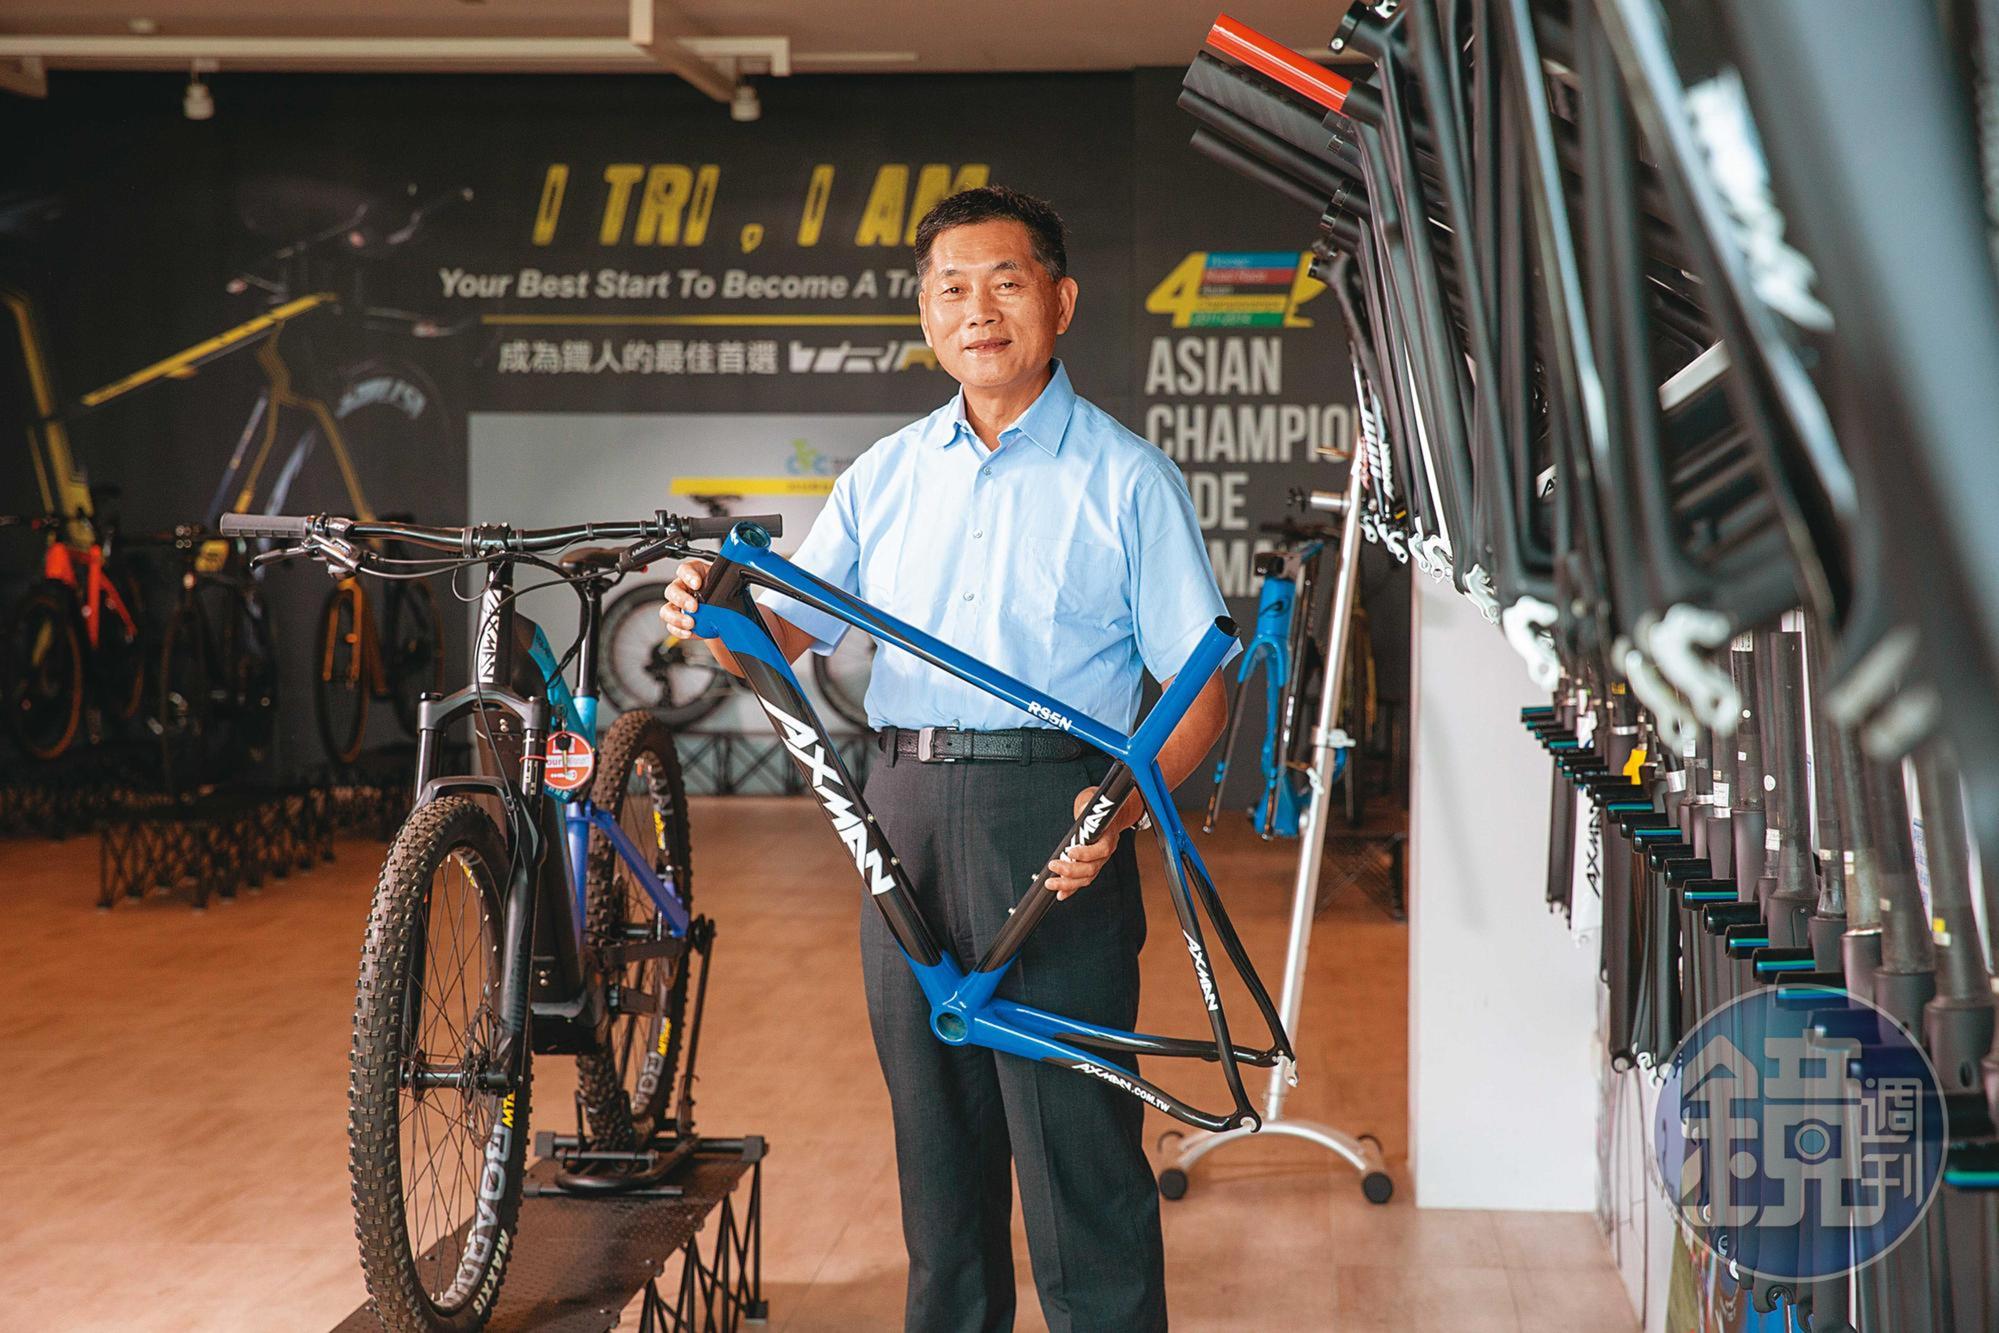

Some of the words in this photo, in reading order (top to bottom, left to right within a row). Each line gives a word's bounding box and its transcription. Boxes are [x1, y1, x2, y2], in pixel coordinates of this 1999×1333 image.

[532, 163, 569, 246] I
[600, 163, 721, 246] TRI
[797, 163, 835, 246] I
[439, 267, 513, 298] Your
[516, 268, 591, 299] Best
[595, 268, 671, 299] Start
[678, 269, 717, 299] To
[721, 268, 848, 299] Become
[853, 269, 879, 299] A
[885, 269, 920, 299] Tr
[1144, 336, 1282, 396] ASIAN
[1144, 404, 1358, 464] CHAMPIO
[1028, 700, 1074, 731] RS5N
[757, 693, 897, 895] AXMAN
[1182, 929, 1219, 1011] AXMAN
[472, 1229, 510, 1316] MAXXIS
